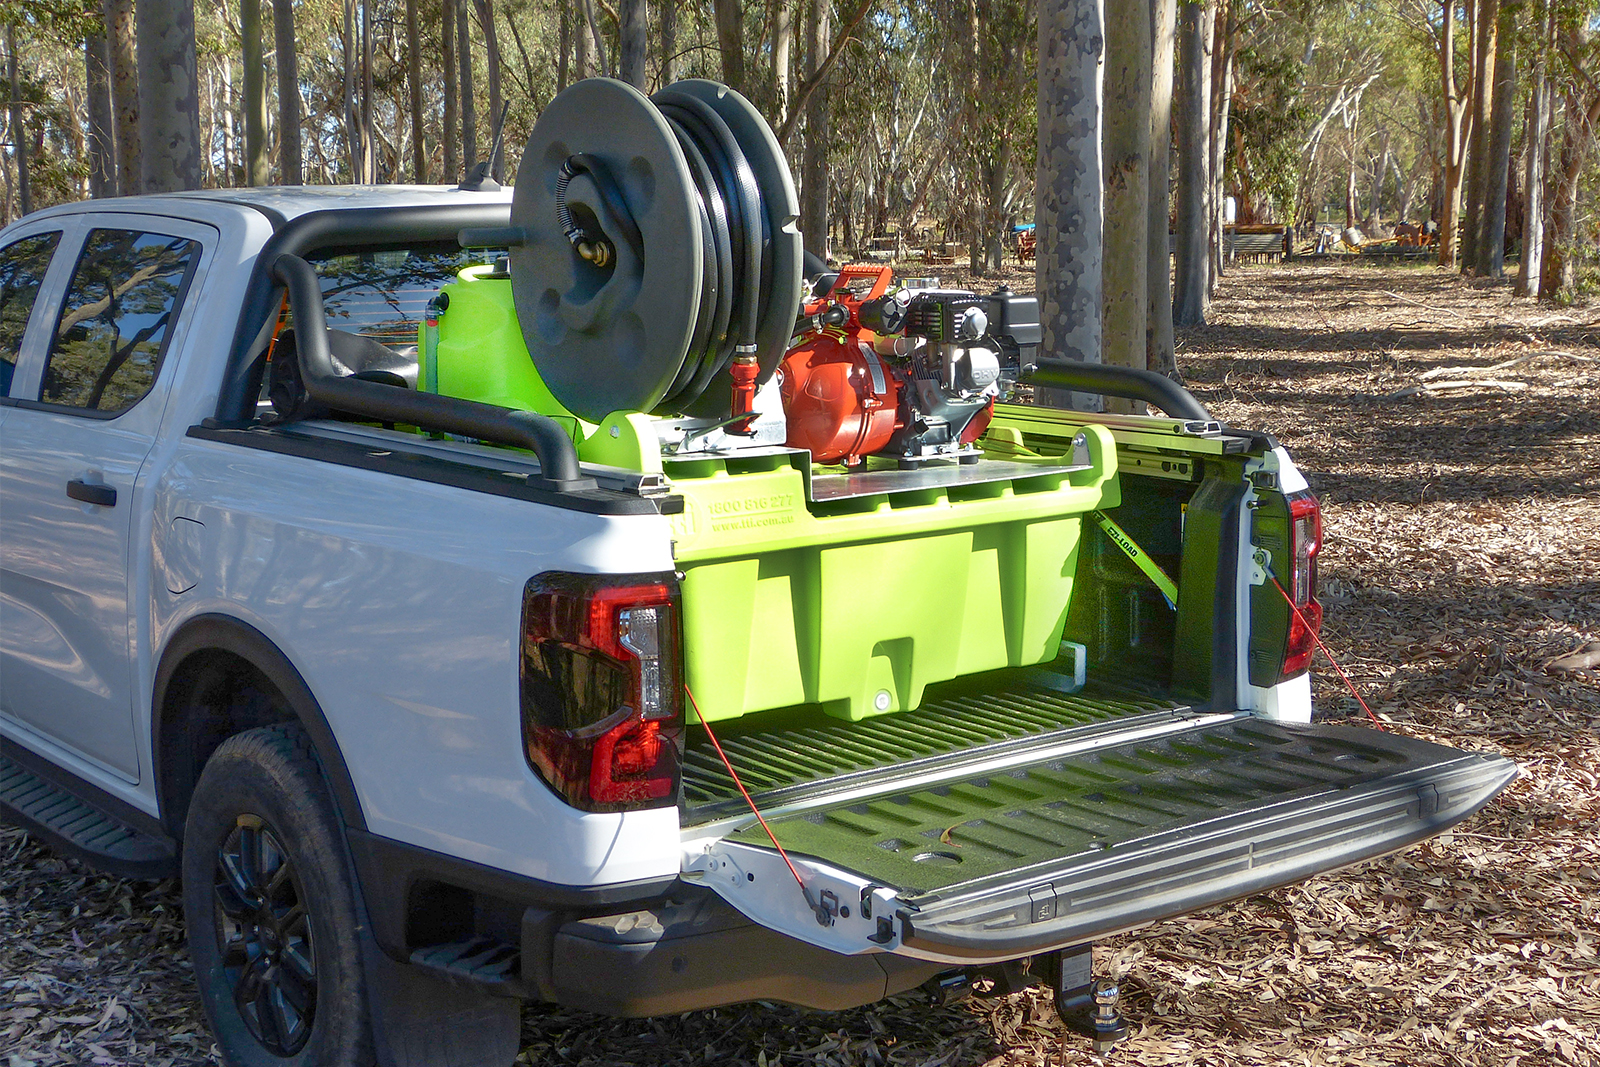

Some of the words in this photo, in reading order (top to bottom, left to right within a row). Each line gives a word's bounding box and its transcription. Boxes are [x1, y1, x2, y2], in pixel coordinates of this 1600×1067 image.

[708, 499, 741, 515] 1800
[744, 496, 768, 511] 816
[770, 493, 794, 508] 277
[1107, 526, 1138, 557] EZI-LOAD
